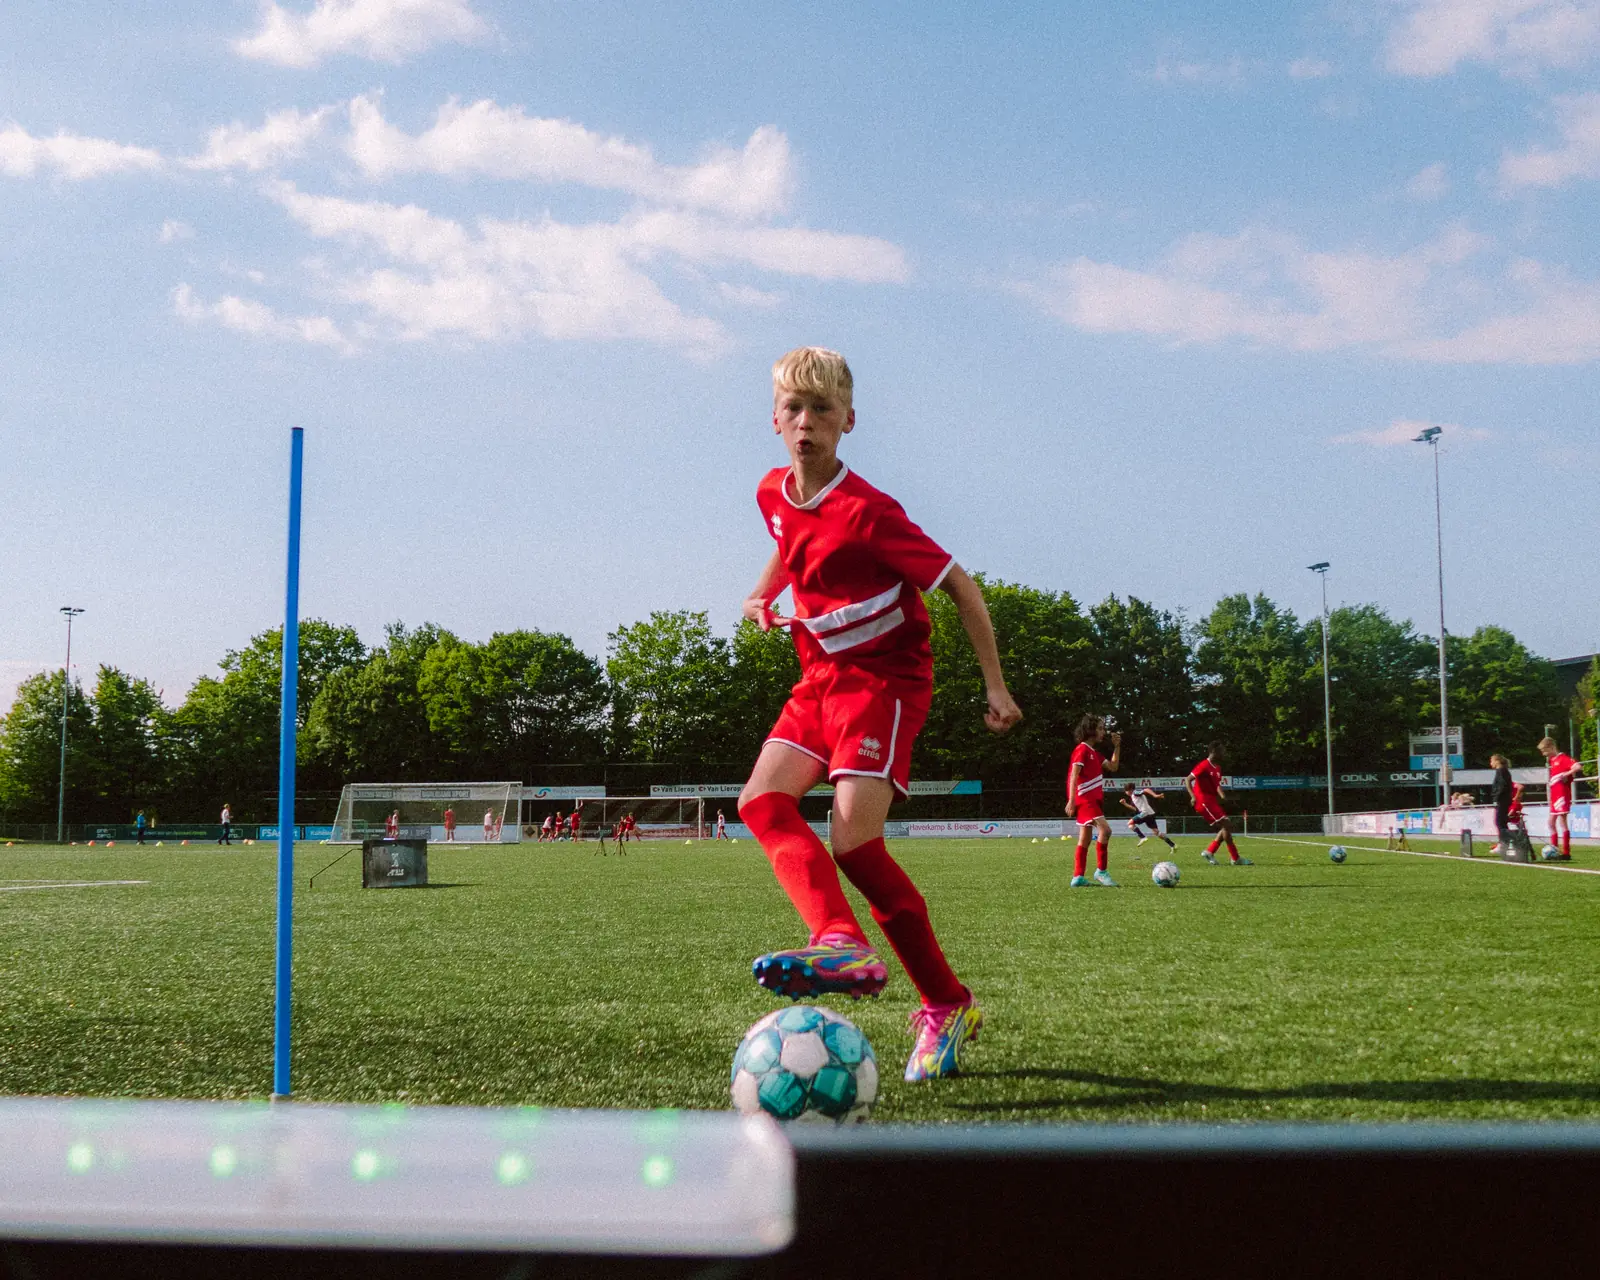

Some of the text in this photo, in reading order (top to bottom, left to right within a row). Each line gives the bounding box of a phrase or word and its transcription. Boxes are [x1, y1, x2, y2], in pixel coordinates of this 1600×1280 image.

[1340, 774, 1379, 782] ODIJK
[1390, 772, 1430, 781] ODIJK
[1233, 777, 1256, 786] RECO
[720, 785, 741, 793] Lierop
[909, 823, 945, 832] Haverkamp
[954, 823, 979, 832] Bergers
